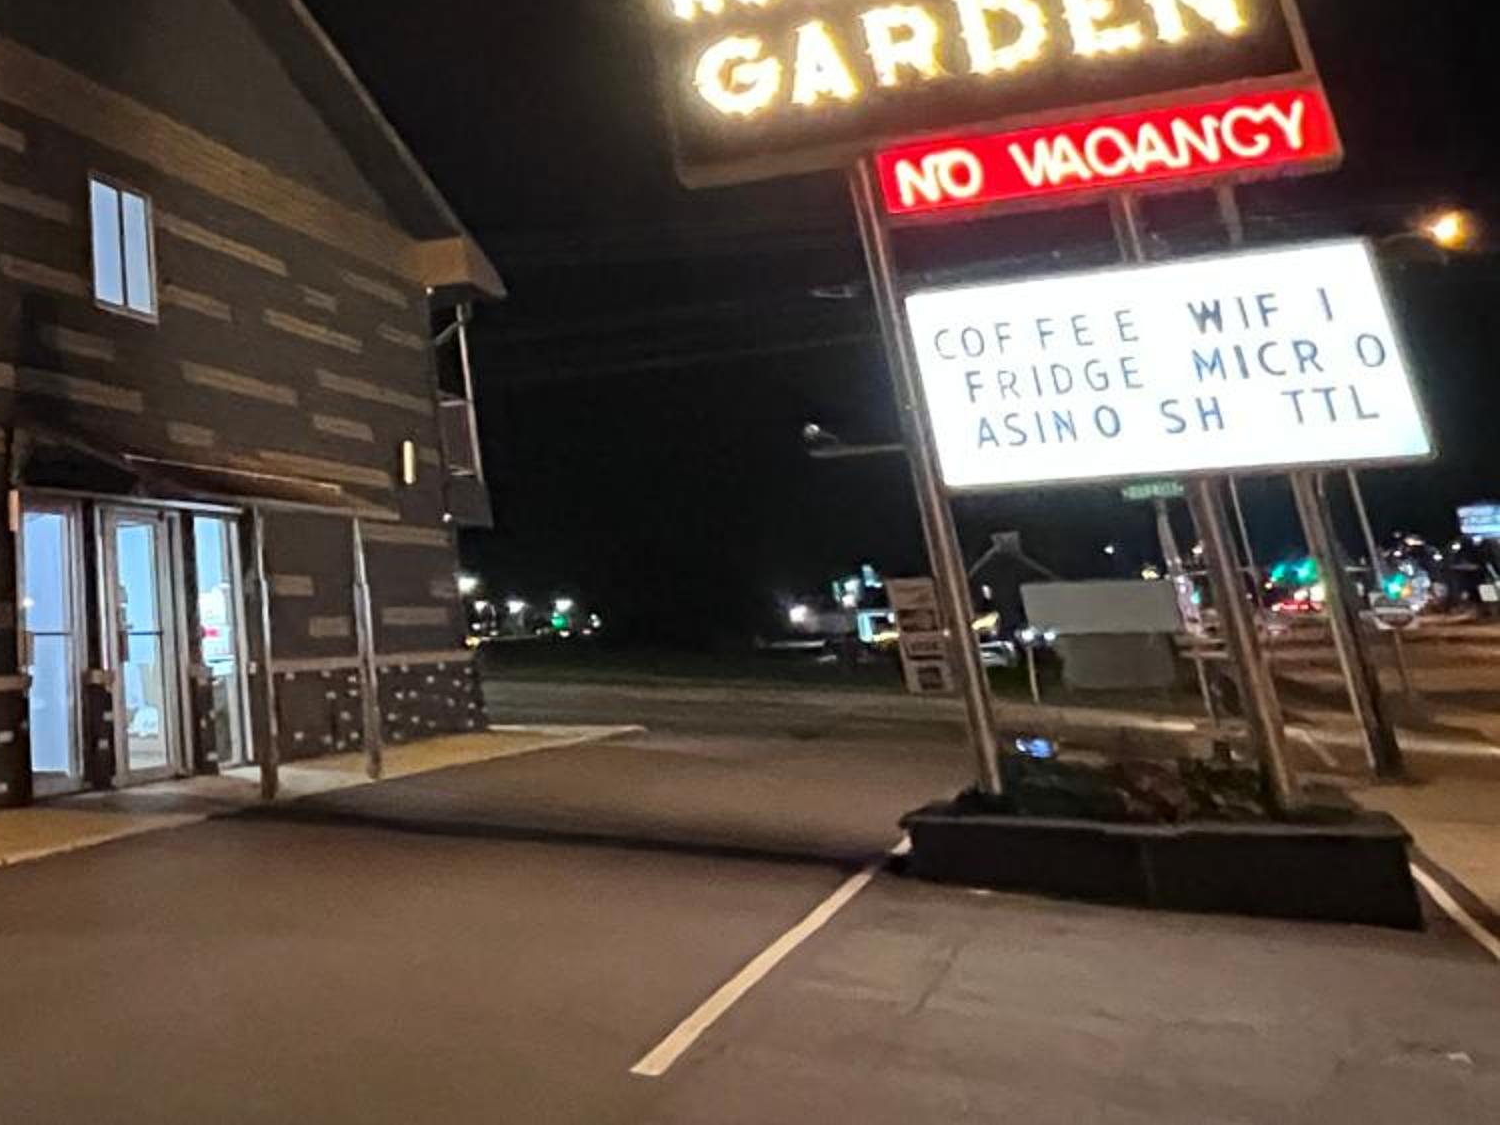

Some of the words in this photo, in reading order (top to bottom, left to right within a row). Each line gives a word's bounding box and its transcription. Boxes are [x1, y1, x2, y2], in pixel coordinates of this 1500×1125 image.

[894, 147, 984, 207] NO
[934, 309, 1140, 360] COFFEE
[964, 356, 1144, 403] FRIDGE
[977, 405, 1121, 448] ASINO
